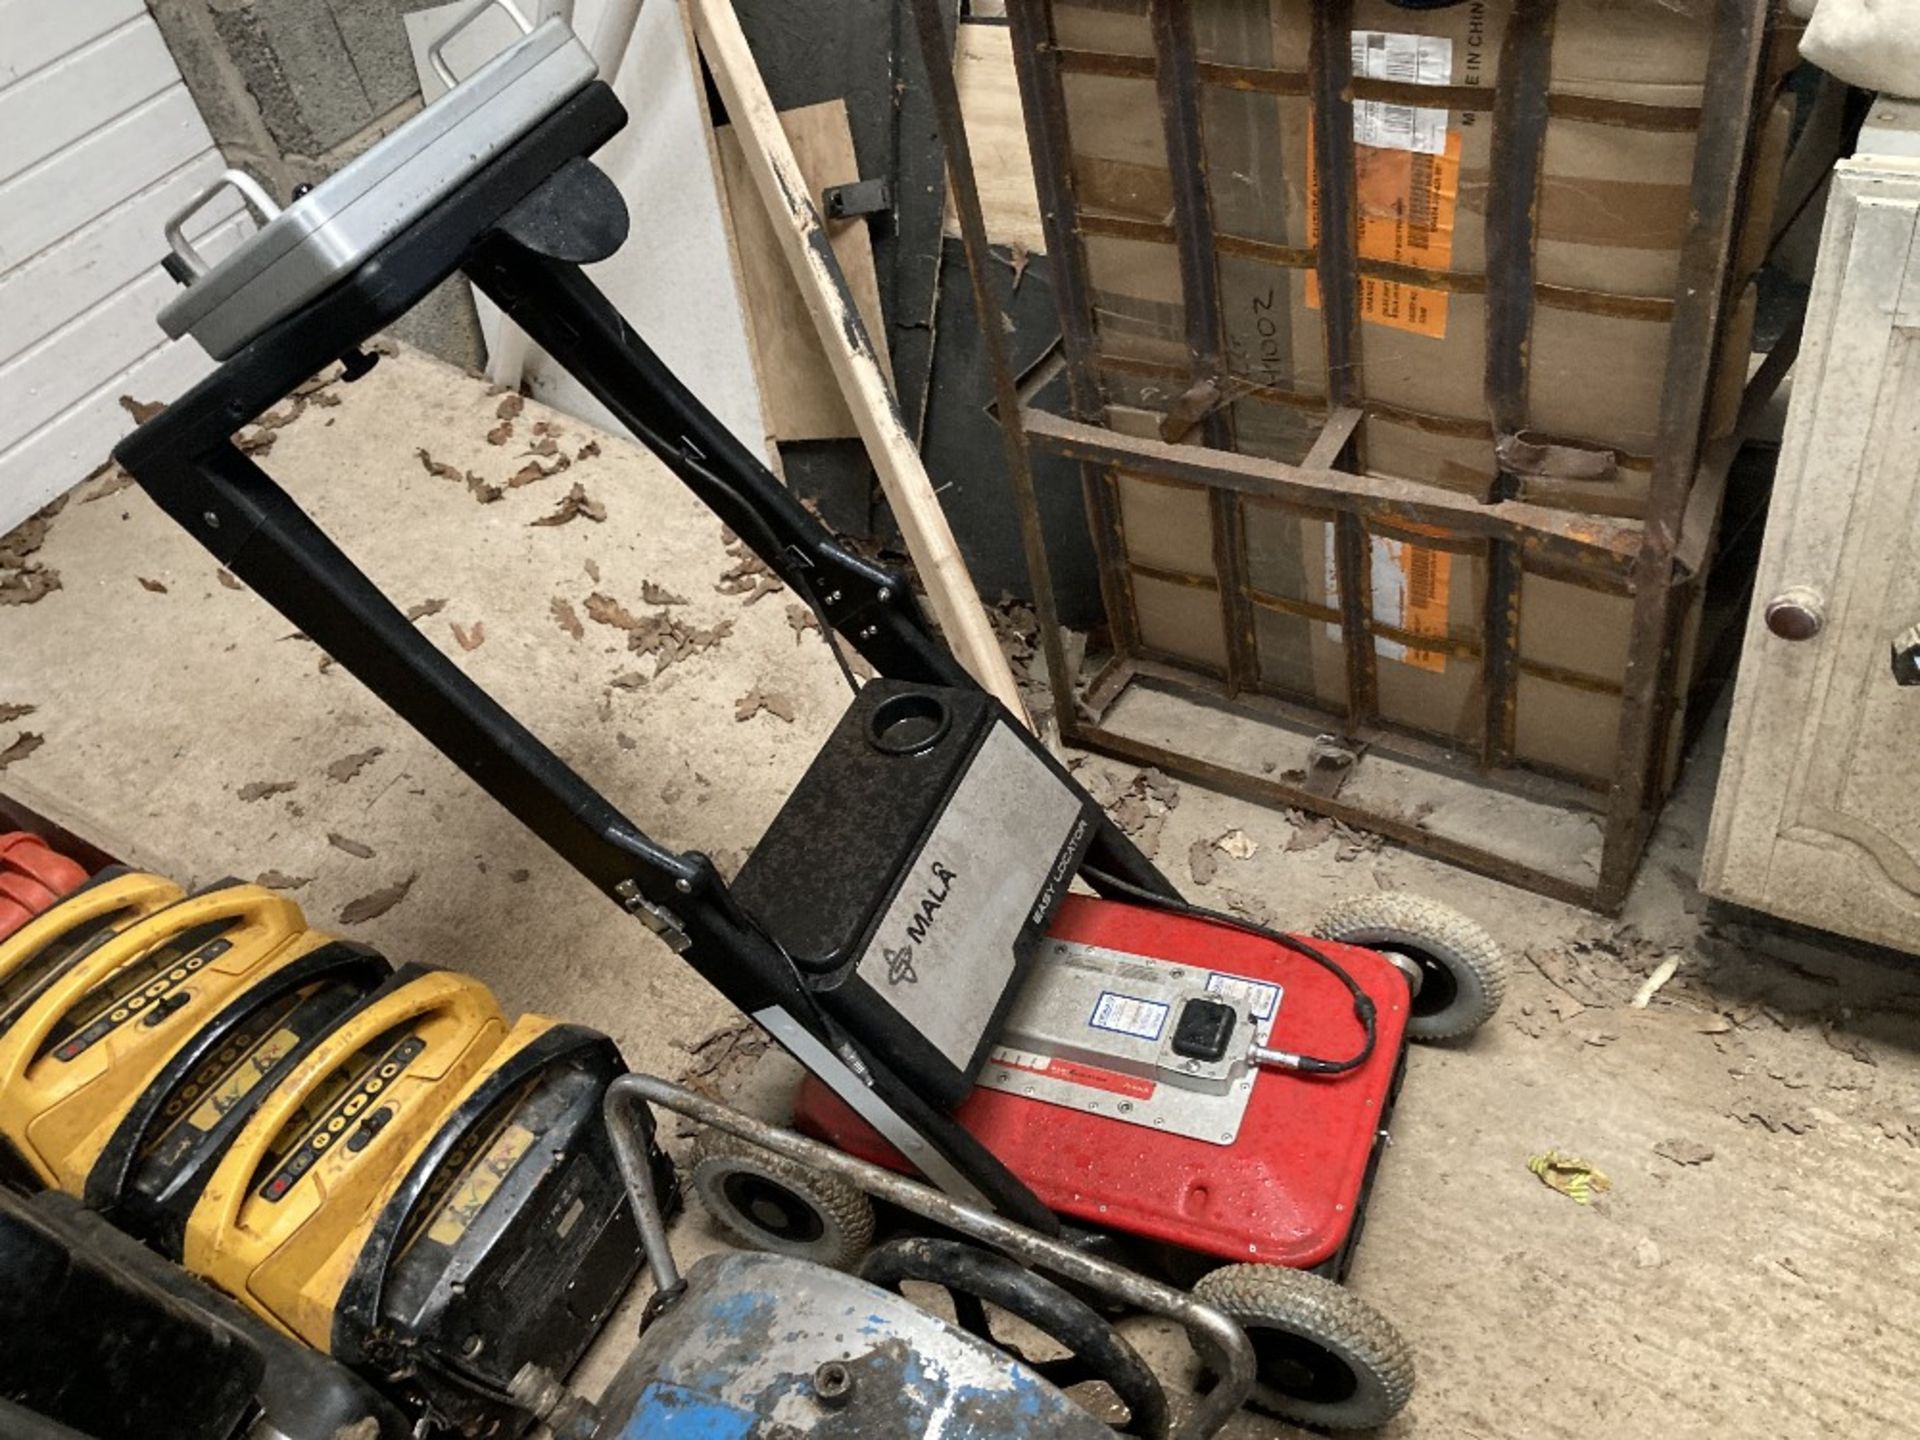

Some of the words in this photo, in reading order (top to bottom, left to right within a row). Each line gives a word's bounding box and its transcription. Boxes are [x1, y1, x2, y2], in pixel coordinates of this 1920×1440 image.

[1467, 1, 1484, 48] CHIN
[1467, 52, 1481, 71] IN
[1462, 74, 1480, 127] ME
[1033, 882, 1056, 925] EASY
[1053, 819, 1089, 883] LOCATOR
